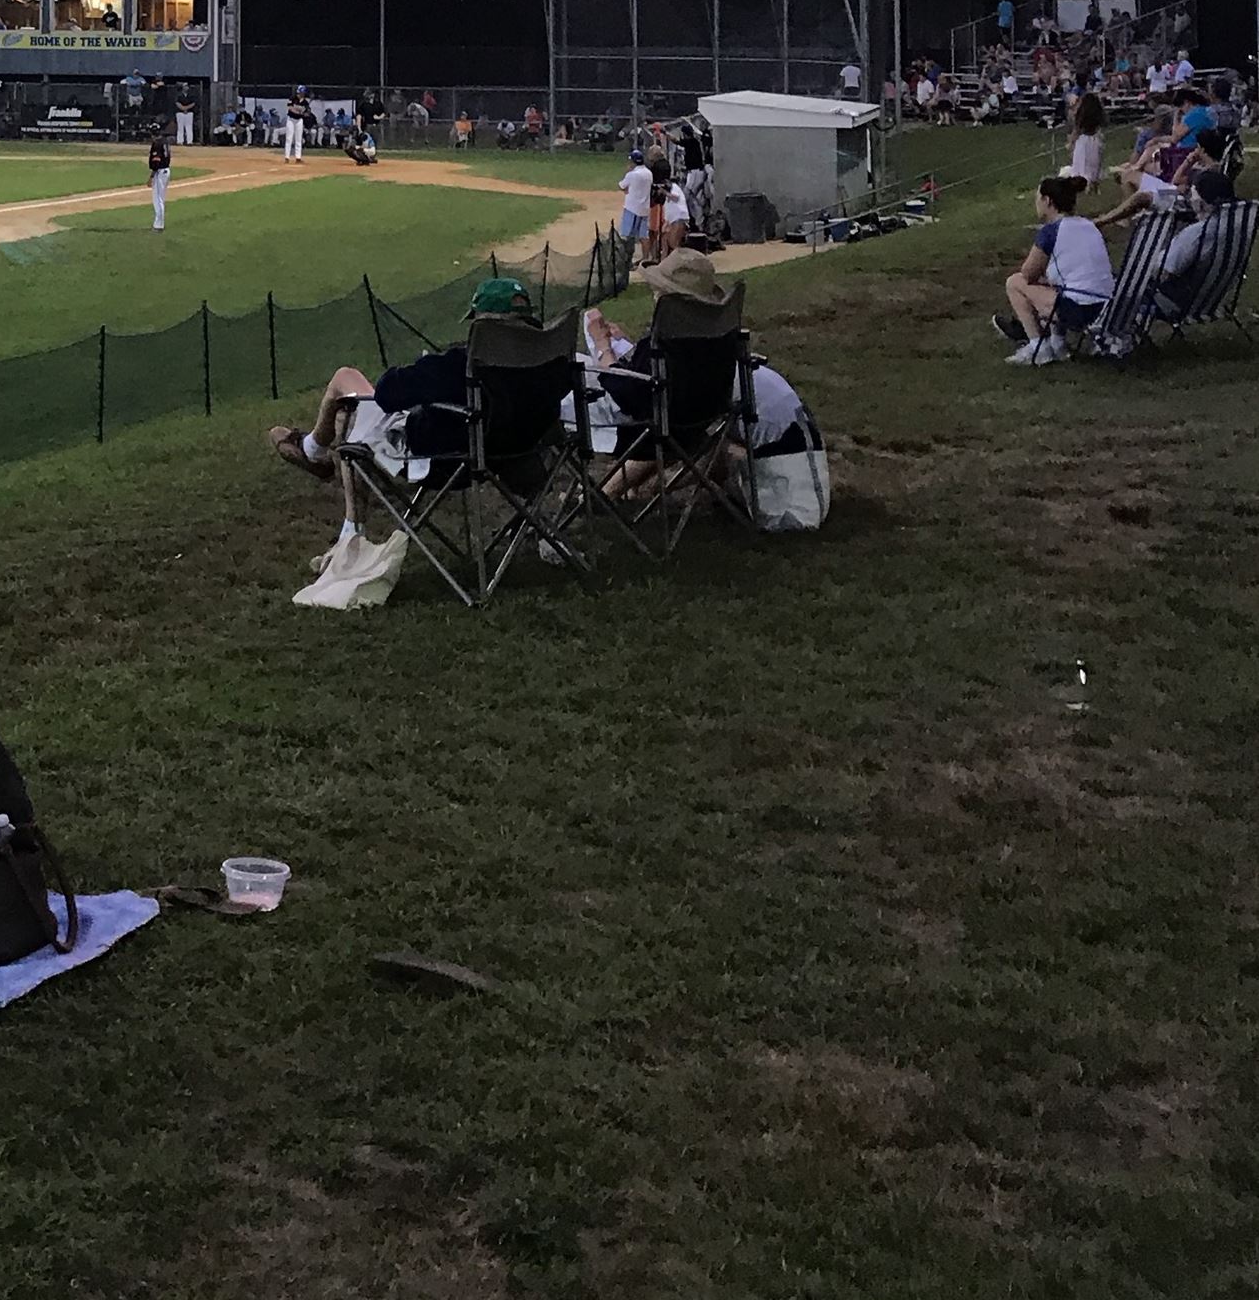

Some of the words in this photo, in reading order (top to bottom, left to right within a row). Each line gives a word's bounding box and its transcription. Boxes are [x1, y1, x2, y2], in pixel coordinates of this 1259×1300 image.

[30, 36, 60, 47] HOME
[63, 36, 76, 47] OF
[80, 37, 101, 47] THE
[105, 37, 146, 47] WAVES
